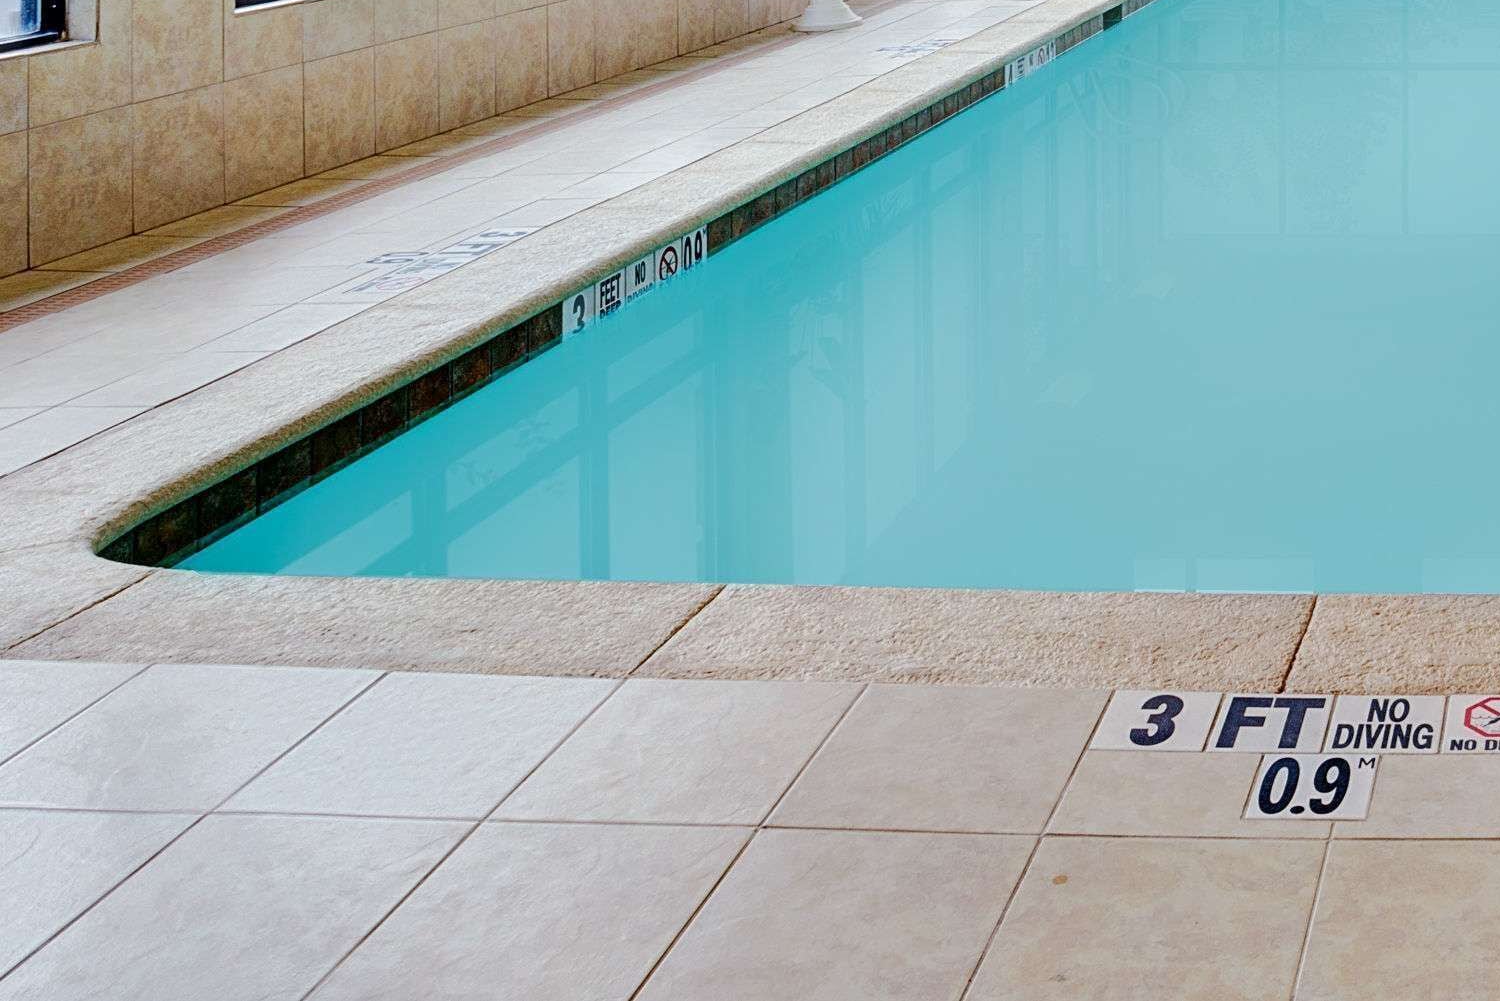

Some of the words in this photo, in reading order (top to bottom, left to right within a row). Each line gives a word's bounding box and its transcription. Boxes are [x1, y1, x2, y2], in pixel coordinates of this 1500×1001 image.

[635, 261, 646, 286] NO
[600, 272, 621, 308] FEET
[573, 294, 585, 334] 3
[1129, 695, 1185, 746] 3
[1215, 697, 1327, 749] FT
[1367, 699, 1410, 723] NO
[1332, 723, 1434, 750] DIVING
[1449, 738, 1478, 751] NO
[1257, 756, 1352, 815] 0.9
[1358, 757, 1376, 769] M
